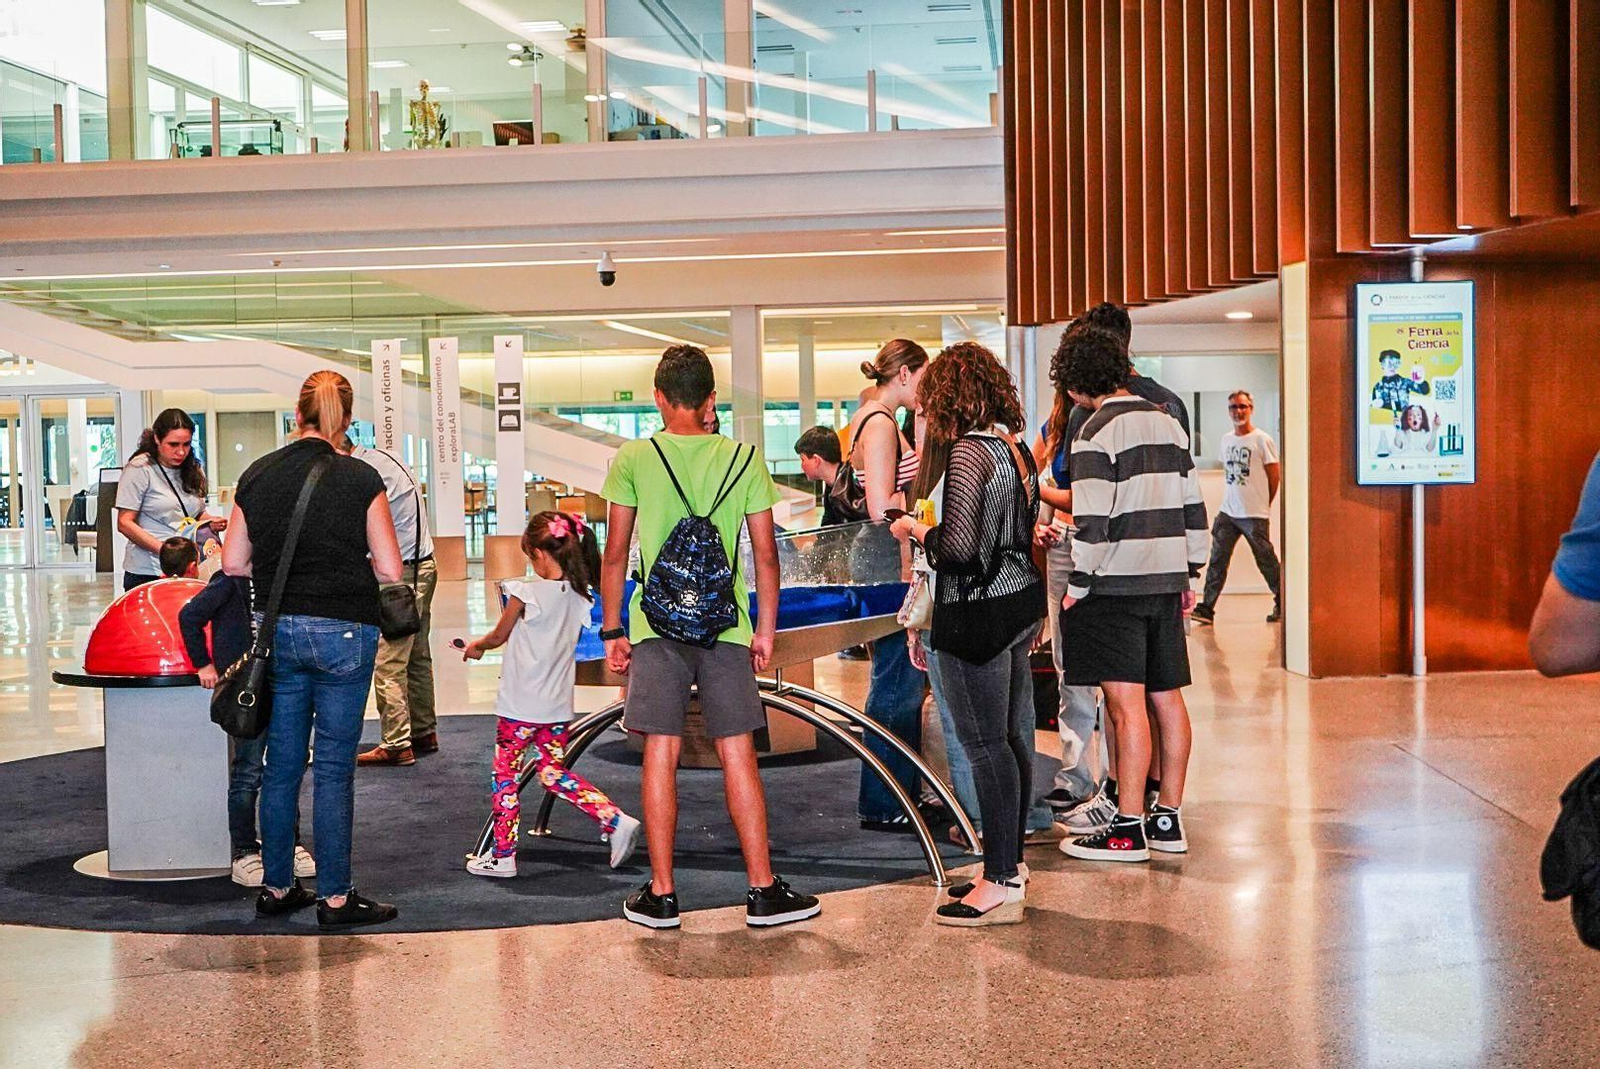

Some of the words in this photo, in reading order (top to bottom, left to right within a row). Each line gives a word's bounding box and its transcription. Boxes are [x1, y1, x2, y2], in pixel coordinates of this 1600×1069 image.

[1408, 326, 1443, 337] Feria
[1408, 339, 1450, 350] Ciencia
[381, 359, 392, 402] oficinas
[434, 356, 444, 417] conocimiento
[436, 418, 444, 433] del
[448, 411, 459, 463] exploraLAB
[438, 435, 446, 463] centro
